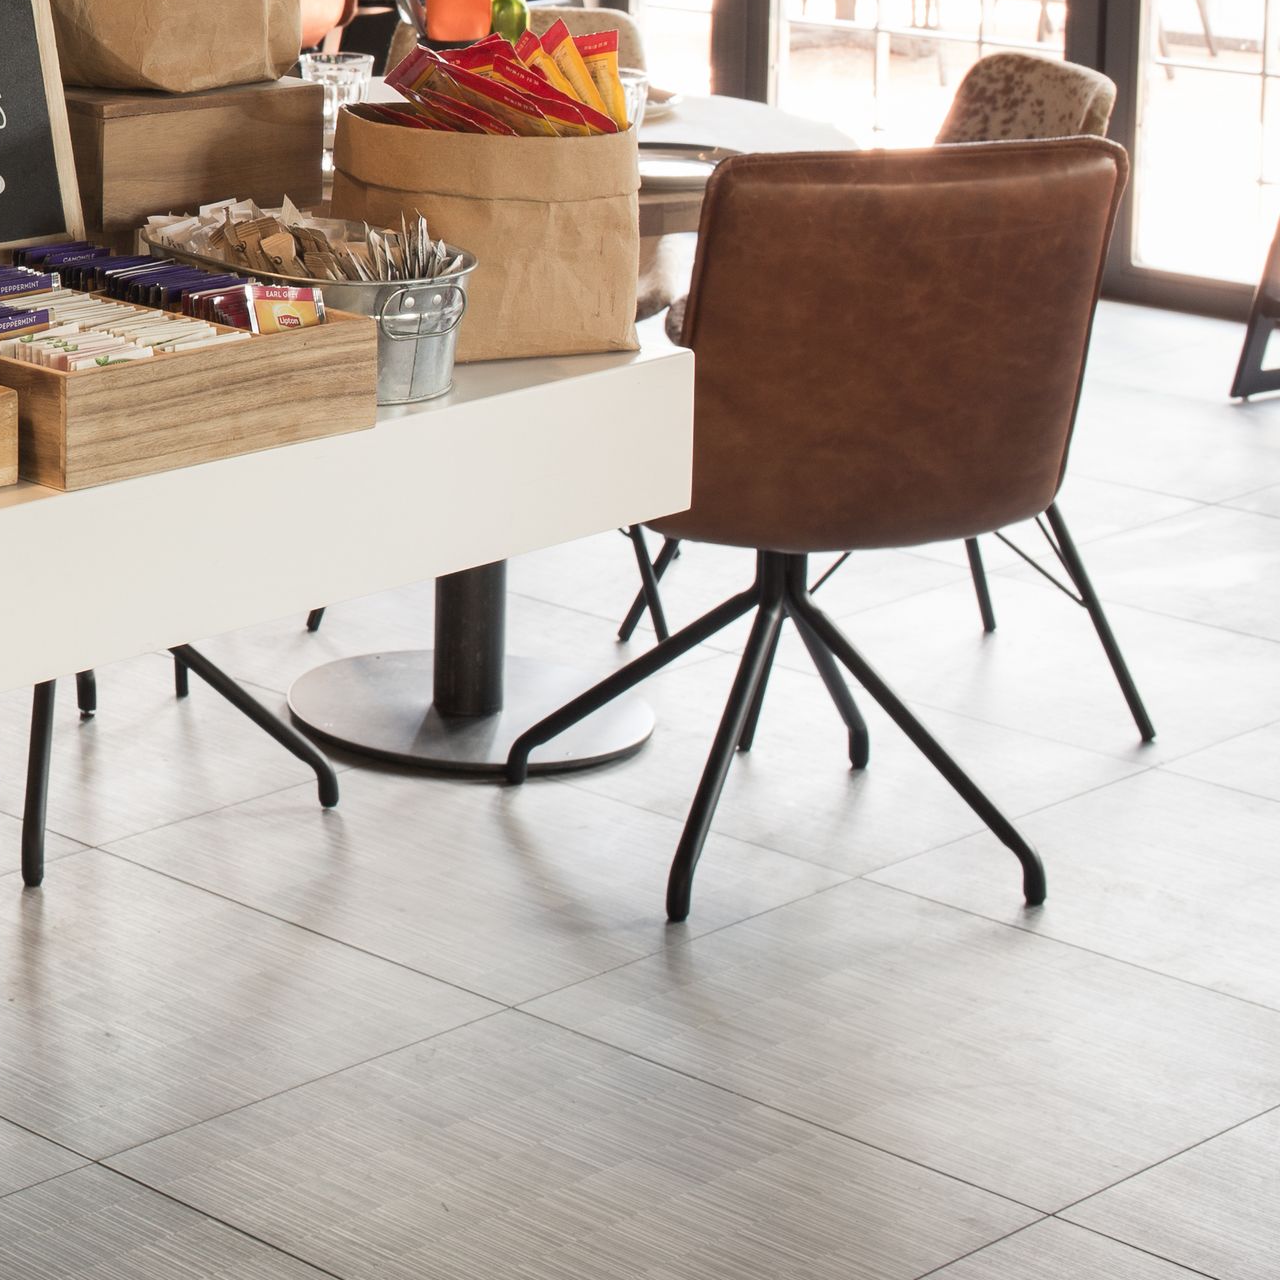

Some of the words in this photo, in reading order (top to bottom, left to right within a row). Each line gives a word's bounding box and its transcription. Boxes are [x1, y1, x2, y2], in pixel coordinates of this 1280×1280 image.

[0, 280, 40, 293] PEPPERMINT
[265, 290, 282, 298] EARL
[279, 316, 300, 326] Lipton
